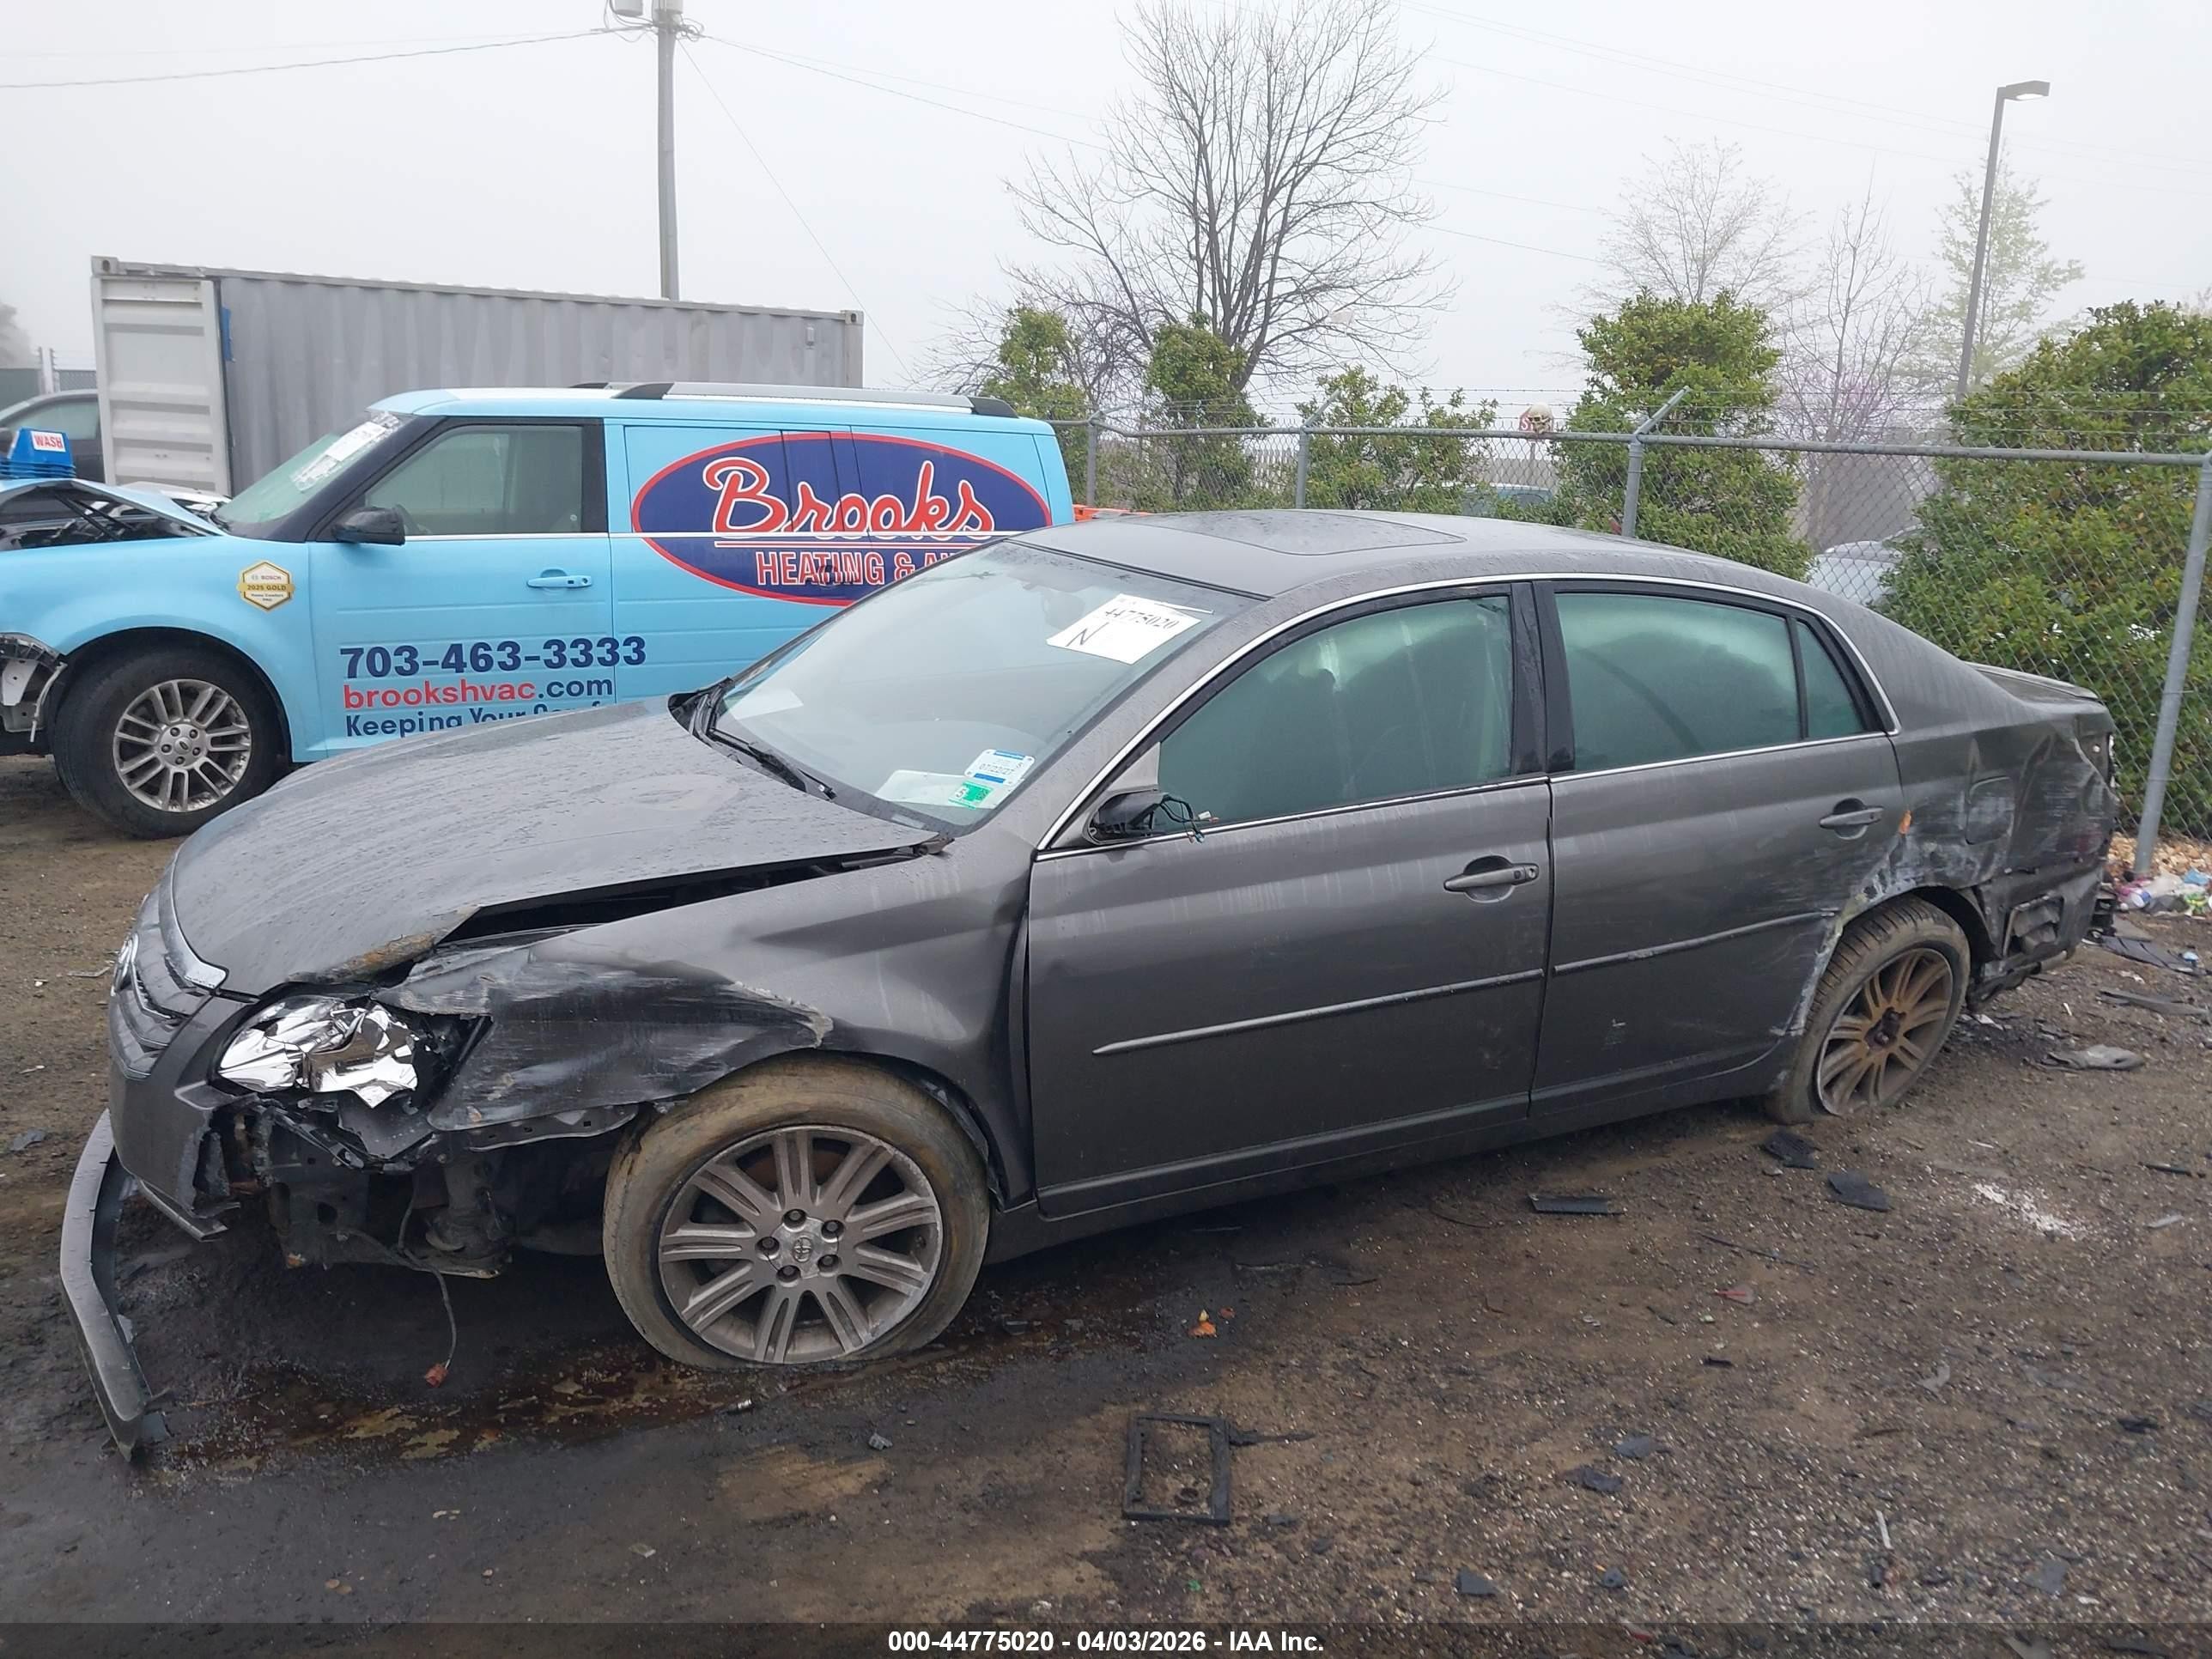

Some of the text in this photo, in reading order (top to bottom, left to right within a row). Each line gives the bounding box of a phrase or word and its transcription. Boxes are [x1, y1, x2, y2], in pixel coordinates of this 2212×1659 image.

[34, 435, 63, 448] WASH
[702, 457, 994, 541] Brooks
[756, 551, 885, 586] HEATING
[894, 551, 916, 581] &
[1103, 608, 1180, 629] 44775020
[340, 635, 647, 679] 703-463-3333
[343, 677, 614, 710] brookshvac.com
